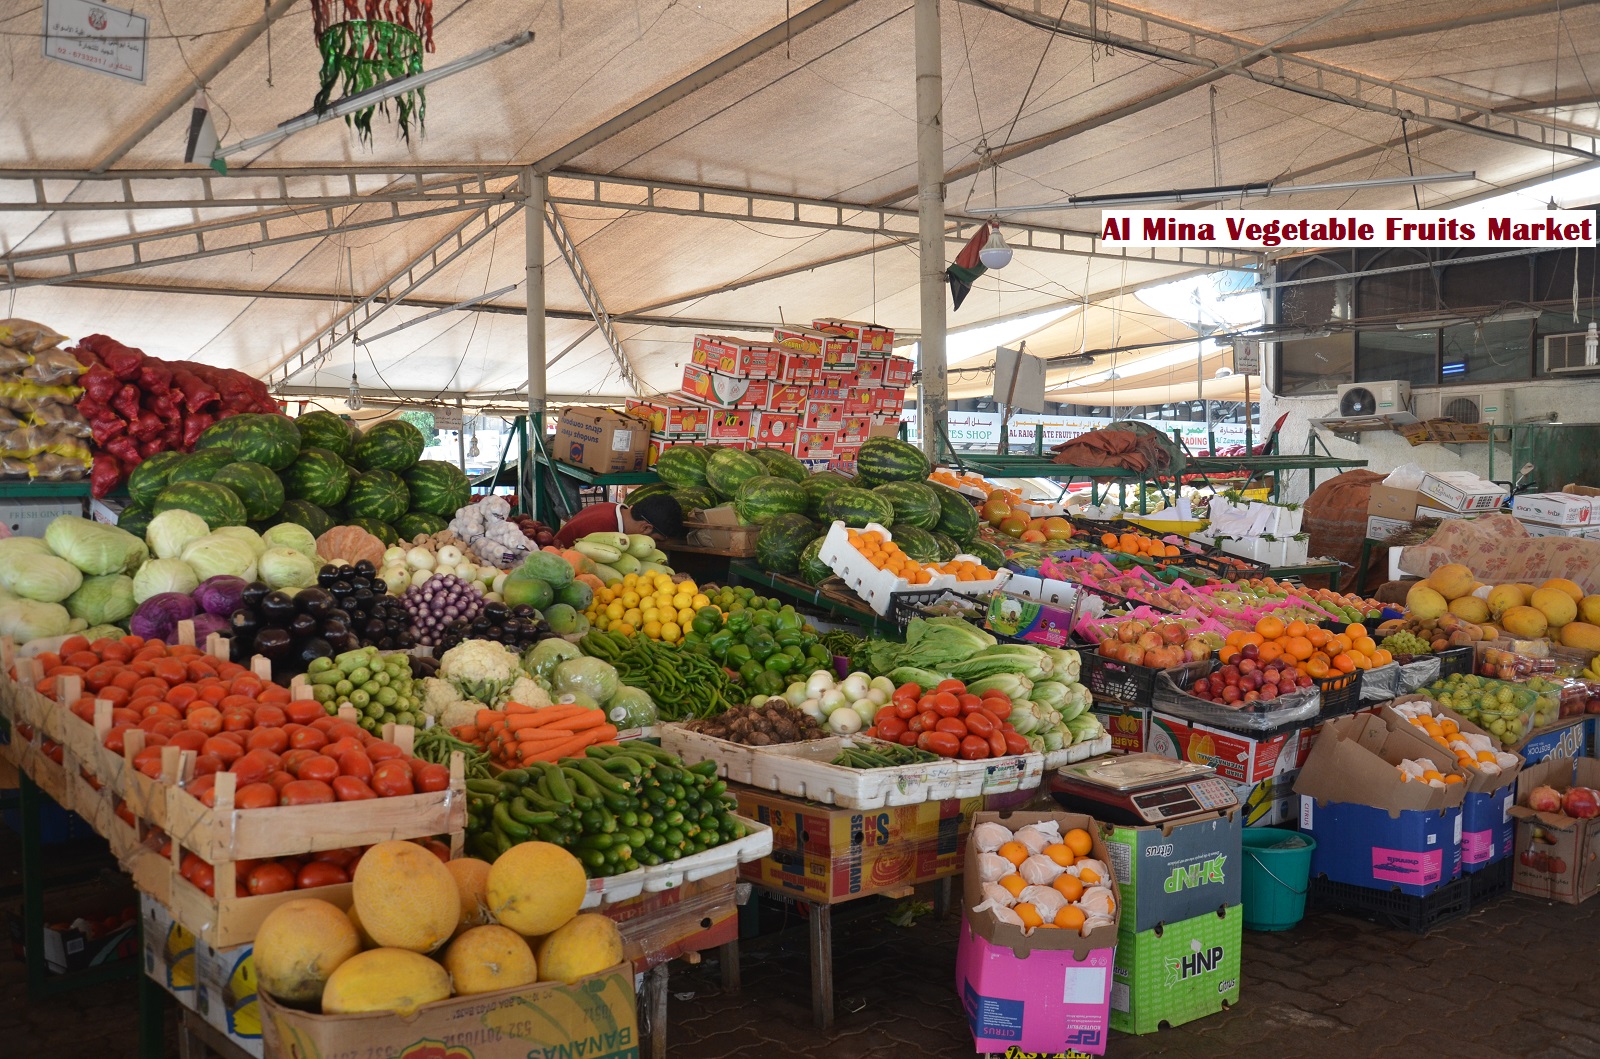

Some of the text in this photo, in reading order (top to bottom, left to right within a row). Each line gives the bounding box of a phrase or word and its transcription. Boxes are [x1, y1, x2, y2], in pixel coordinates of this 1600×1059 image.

[726, 416, 739, 426] KT
[585, 424, 603, 434] citrus
[1009, 429, 1018, 437] AL
[1043, 430, 1055, 438] ATE
[1055, 430, 1072, 438] FRUIT
[574, 431, 599, 444] sundays
[966, 430, 992, 440] SHOP
[9, 511, 37, 519] FRESH
[1225, 768, 1244, 779] UMAR
[1145, 843, 1173, 857] Citrus
[1163, 860, 1208, 894] HNP
[1182, 946, 1223, 979] HNP
[1112, 965, 1128, 977] itrus
[1218, 978, 1236, 994] Citrus
[983, 1027, 1015, 1037] CITRUS
[526, 1026, 632, 1059] BANANAS
